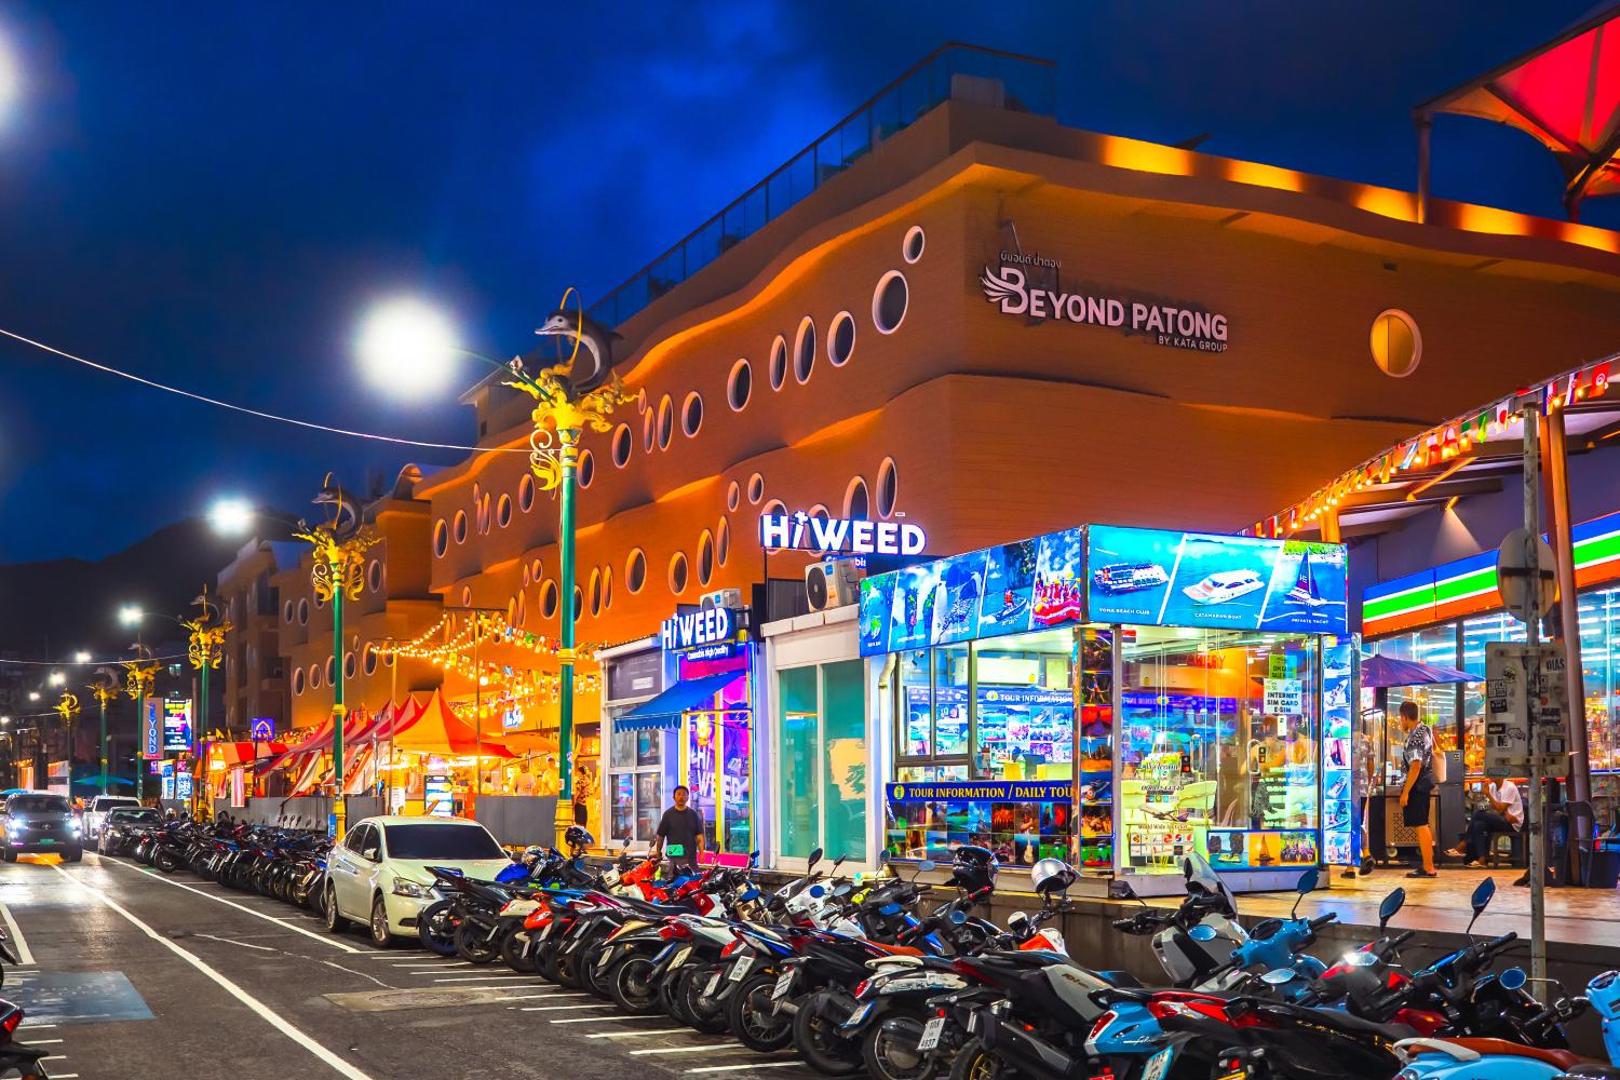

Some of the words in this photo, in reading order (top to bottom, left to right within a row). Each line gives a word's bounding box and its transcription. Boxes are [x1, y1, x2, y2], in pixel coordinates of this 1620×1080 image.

[981, 266, 1125, 327] BEYOND
[1132, 303, 1228, 342] PATONG
[1158, 335, 1170, 345] BY
[1174, 338, 1197, 349] KATA
[1199, 341, 1228, 352] GROUP
[1000, 694, 1021, 702] TOUR
[909, 787, 934, 798] TOUR
[935, 787, 1005, 798] INFORMATION
[1015, 787, 1046, 798] DAILY
